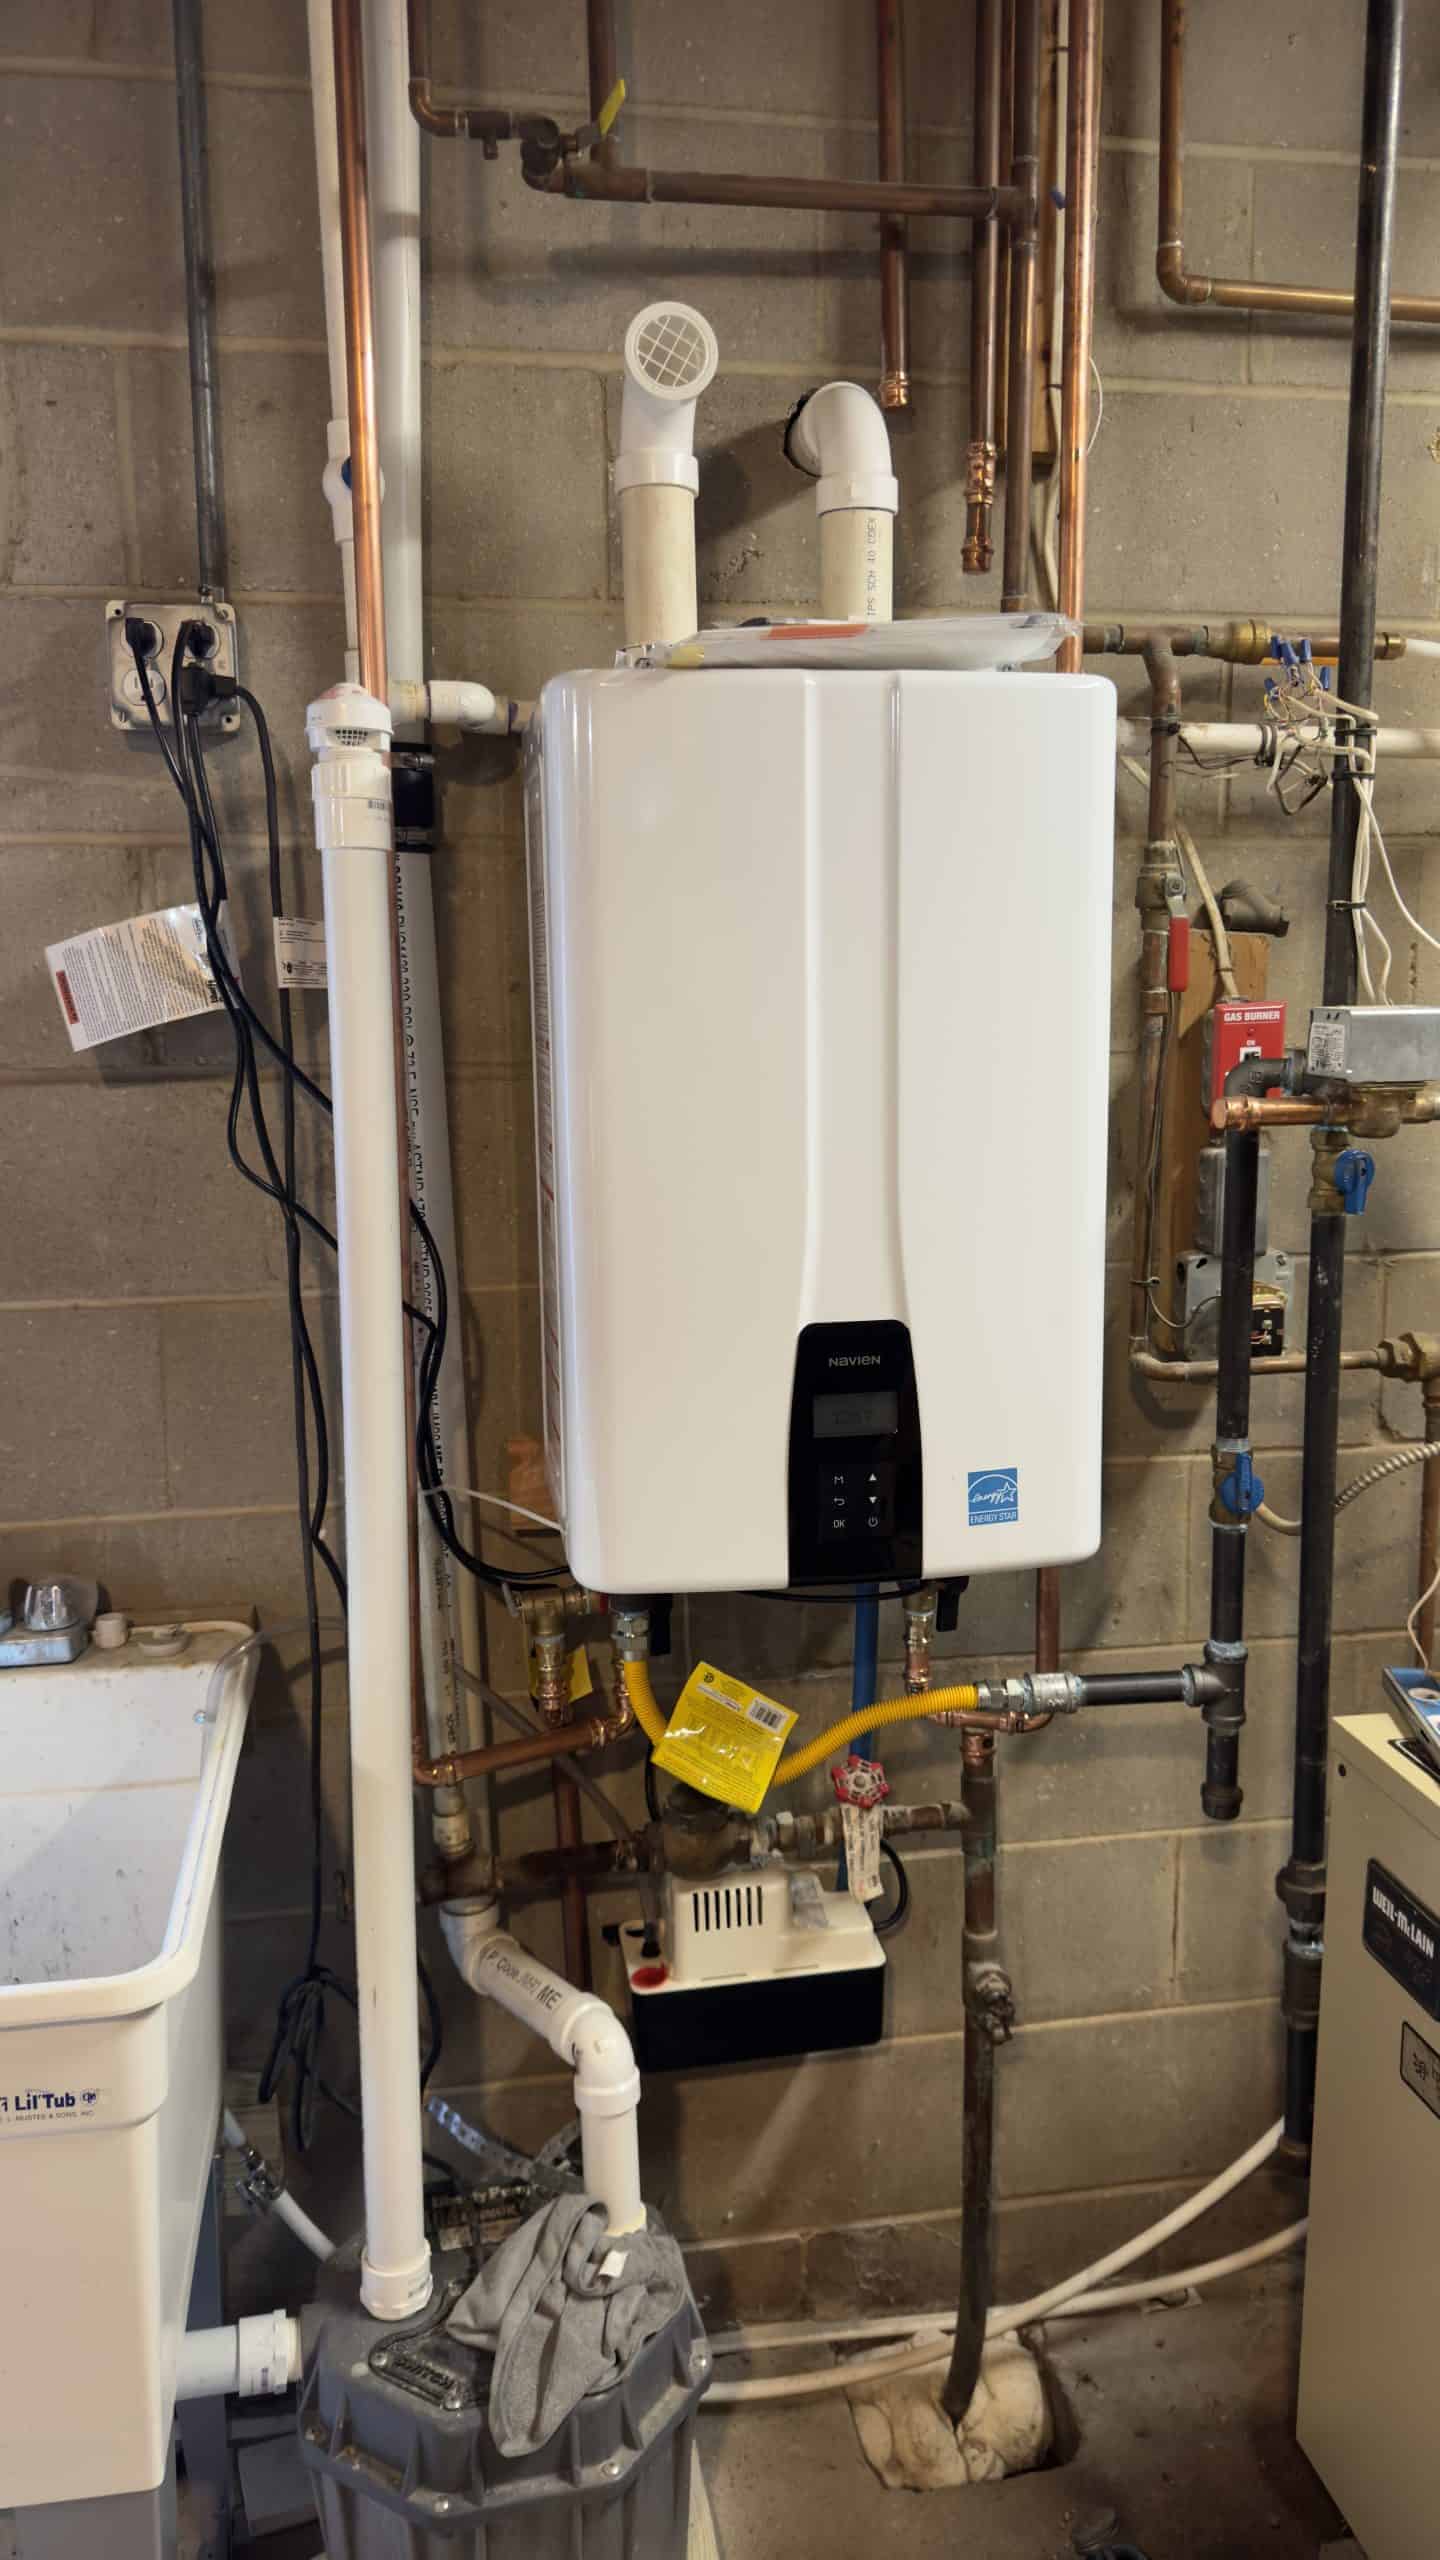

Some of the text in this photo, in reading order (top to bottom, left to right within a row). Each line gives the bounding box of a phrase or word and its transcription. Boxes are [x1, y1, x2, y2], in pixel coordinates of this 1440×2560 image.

[1224, 1010, 1280, 1022] GAS BURNER
[970, 1510, 1017, 1525] ENERGY STAR
[833, 1519, 846, 1529] OK
